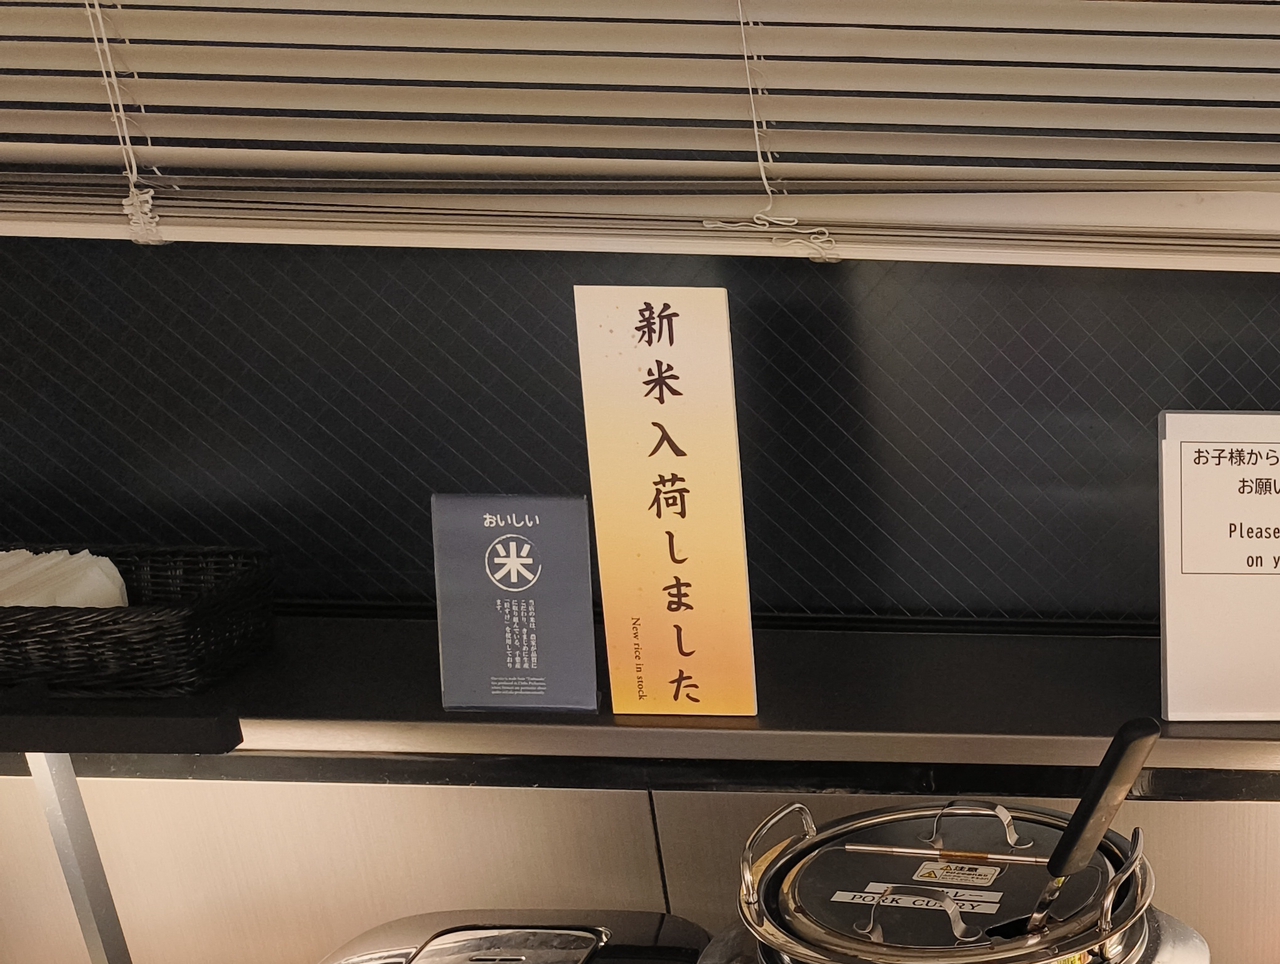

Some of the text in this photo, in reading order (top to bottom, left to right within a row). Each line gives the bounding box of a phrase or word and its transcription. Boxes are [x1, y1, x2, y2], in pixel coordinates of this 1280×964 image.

[634, 301, 701, 703] 新米入荷しました
[483, 513, 540, 528] おいしい
[1228, 523, 1280, 540] Please
[494, 542, 533, 583] 米
[1246, 555, 1263, 568] on
[631, 617, 648, 700] New rice in stock
[912, 900, 981, 911] CURY
